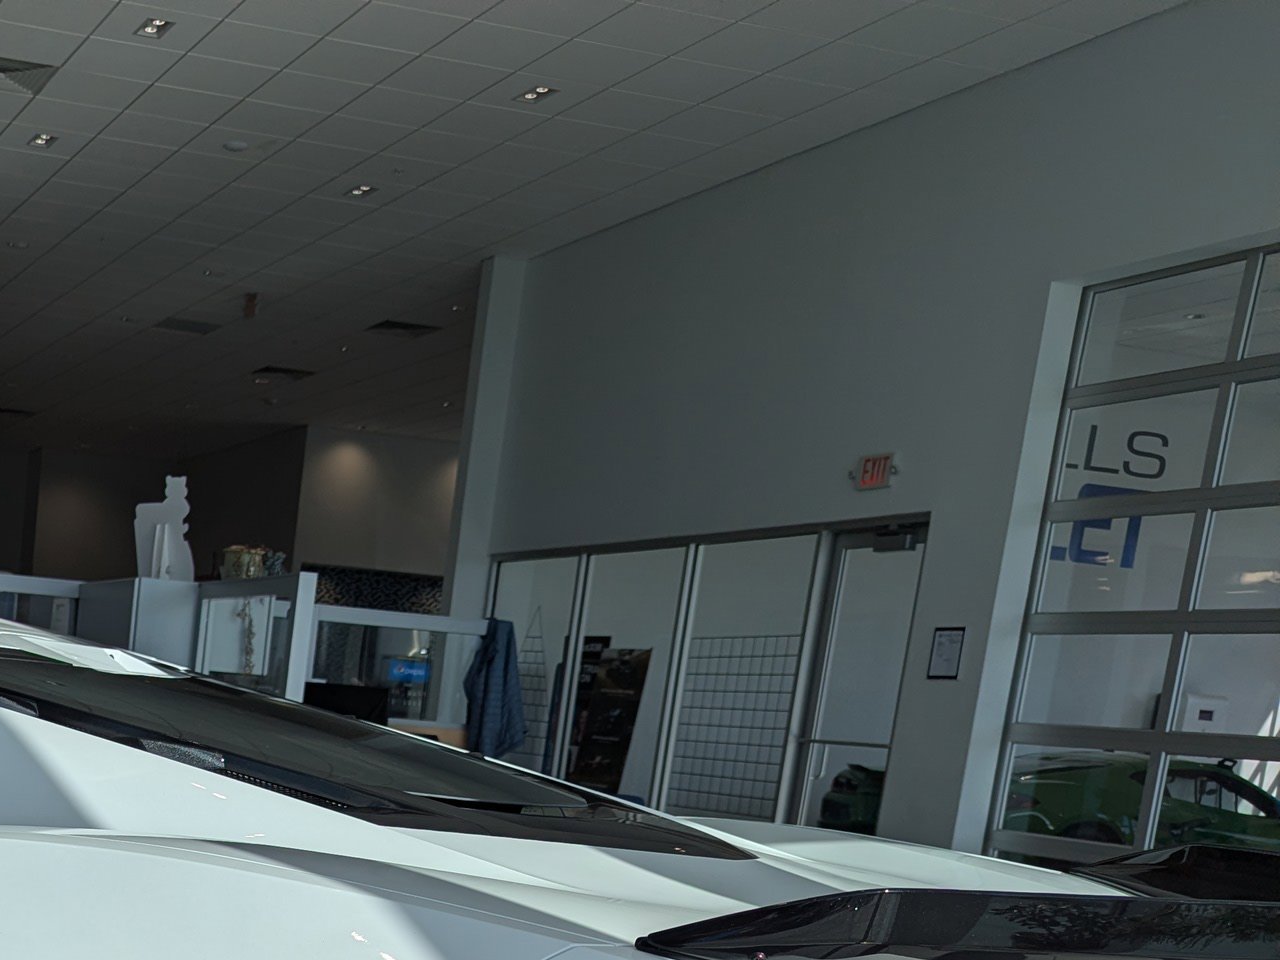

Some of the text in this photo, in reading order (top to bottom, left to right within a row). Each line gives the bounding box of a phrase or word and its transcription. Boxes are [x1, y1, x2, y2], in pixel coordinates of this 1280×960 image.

[861, 456, 890, 484] EXIT
[1065, 424, 1170, 480] LS
[1049, 483, 1156, 569] ET
